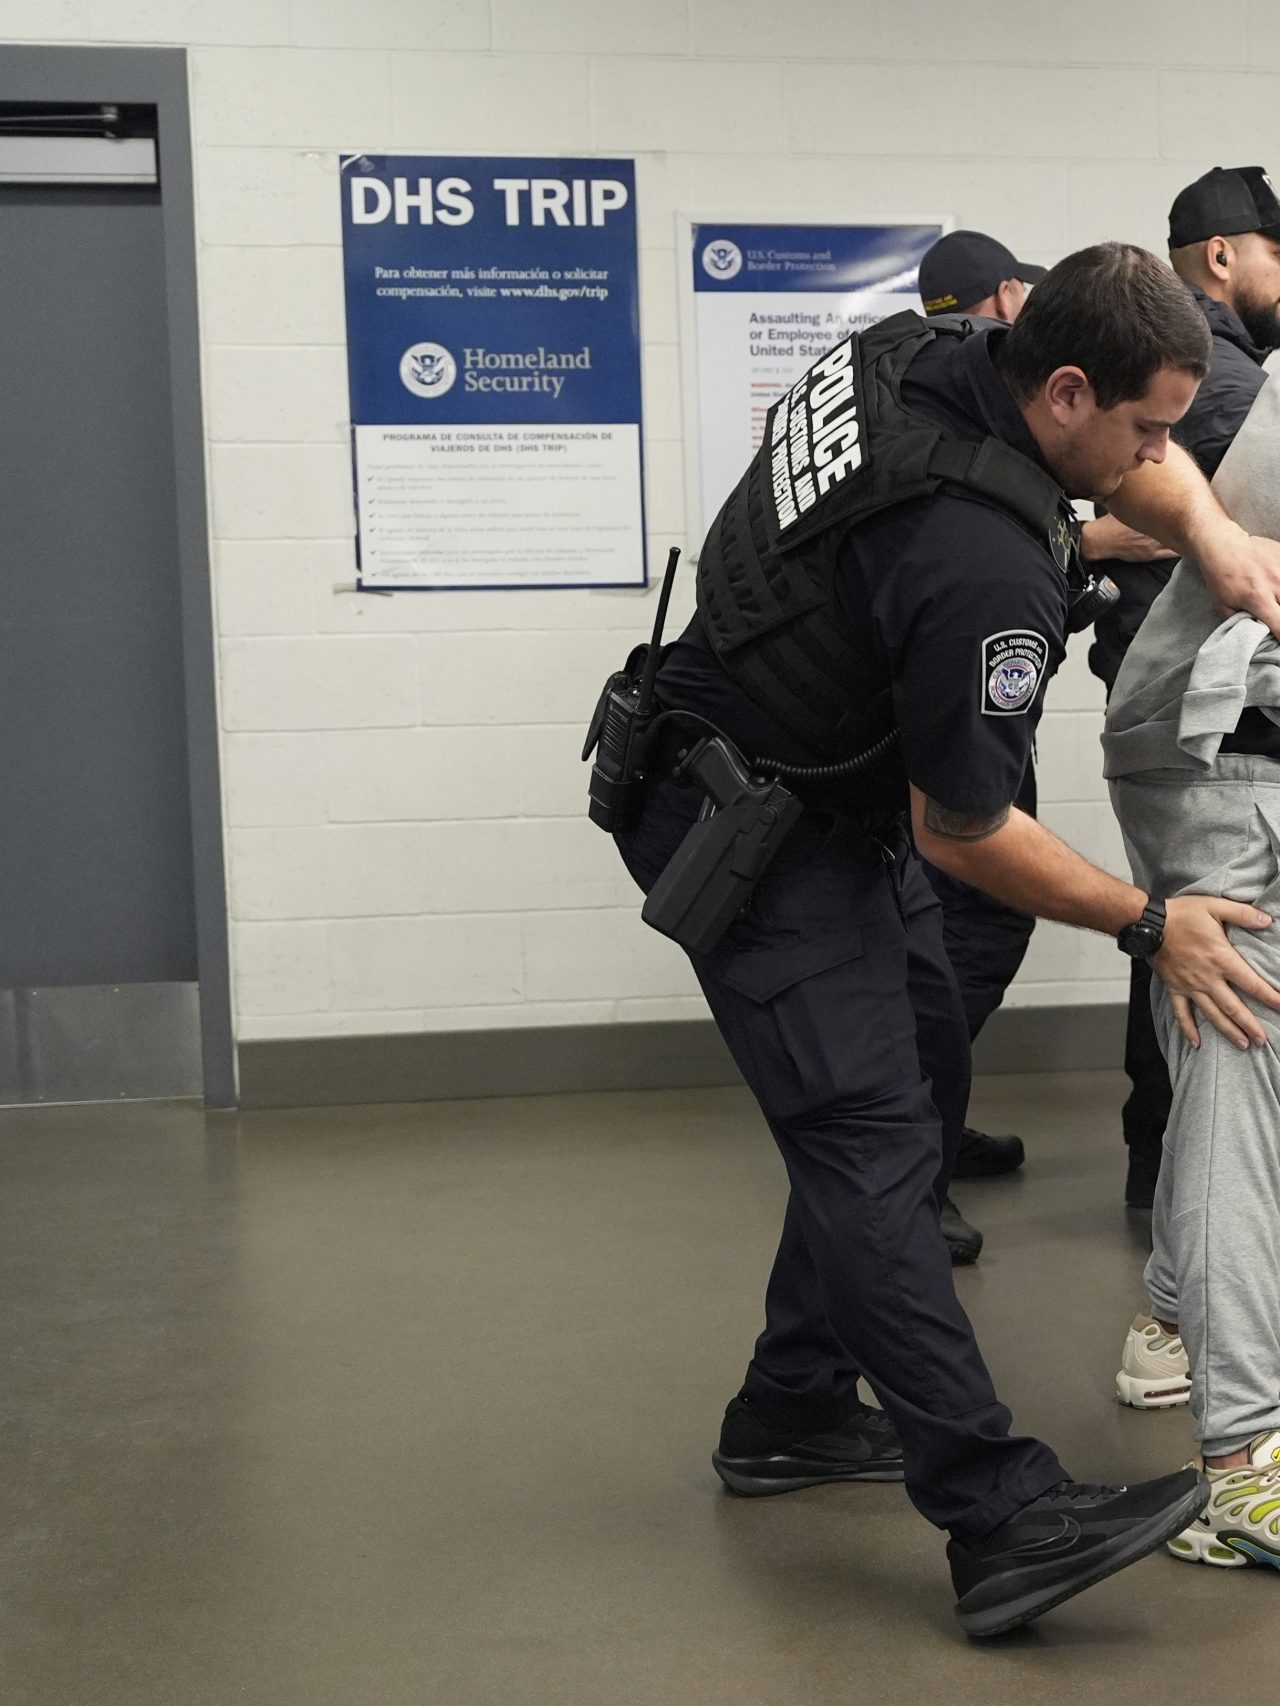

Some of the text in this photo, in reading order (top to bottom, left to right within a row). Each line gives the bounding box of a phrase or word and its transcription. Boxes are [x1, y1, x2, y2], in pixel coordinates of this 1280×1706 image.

[350, 177, 629, 227] DHS TRIP
[768, 250, 811, 260] Customs
[813, 250, 832, 260] and
[375, 266, 608, 280] Para obtener más información o solicitar
[747, 261, 836, 271] Border Protection
[376, 284, 608, 301] compensación, visite www.dhs.gov/trip
[750, 312, 821, 327] Assaulting
[749, 328, 849, 343] or Employee of
[463, 346, 592, 369] Homeland
[750, 344, 794, 356] United
[464, 370, 565, 398] Security
[809, 338, 862, 496] POLICE
[383, 432, 438, 441] PROGRAMA
[440, 432, 453, 441] DE
[456, 432, 504, 441] CONSULTA
[507, 432, 519, 441] DE
[600, 431, 614, 441] DE
[789, 400, 811, 476] CUSTOMS
[430, 443, 567, 453] VIAJEROS DE DHS (DHS TRIP)
[771, 438, 799, 530] PROTECTION
[794, 471, 817, 514] AND
[994, 641, 1008, 652] U.S.
[1009, 638, 1038, 650] CUSTOMS
[989, 650, 1014, 667] BORDER
